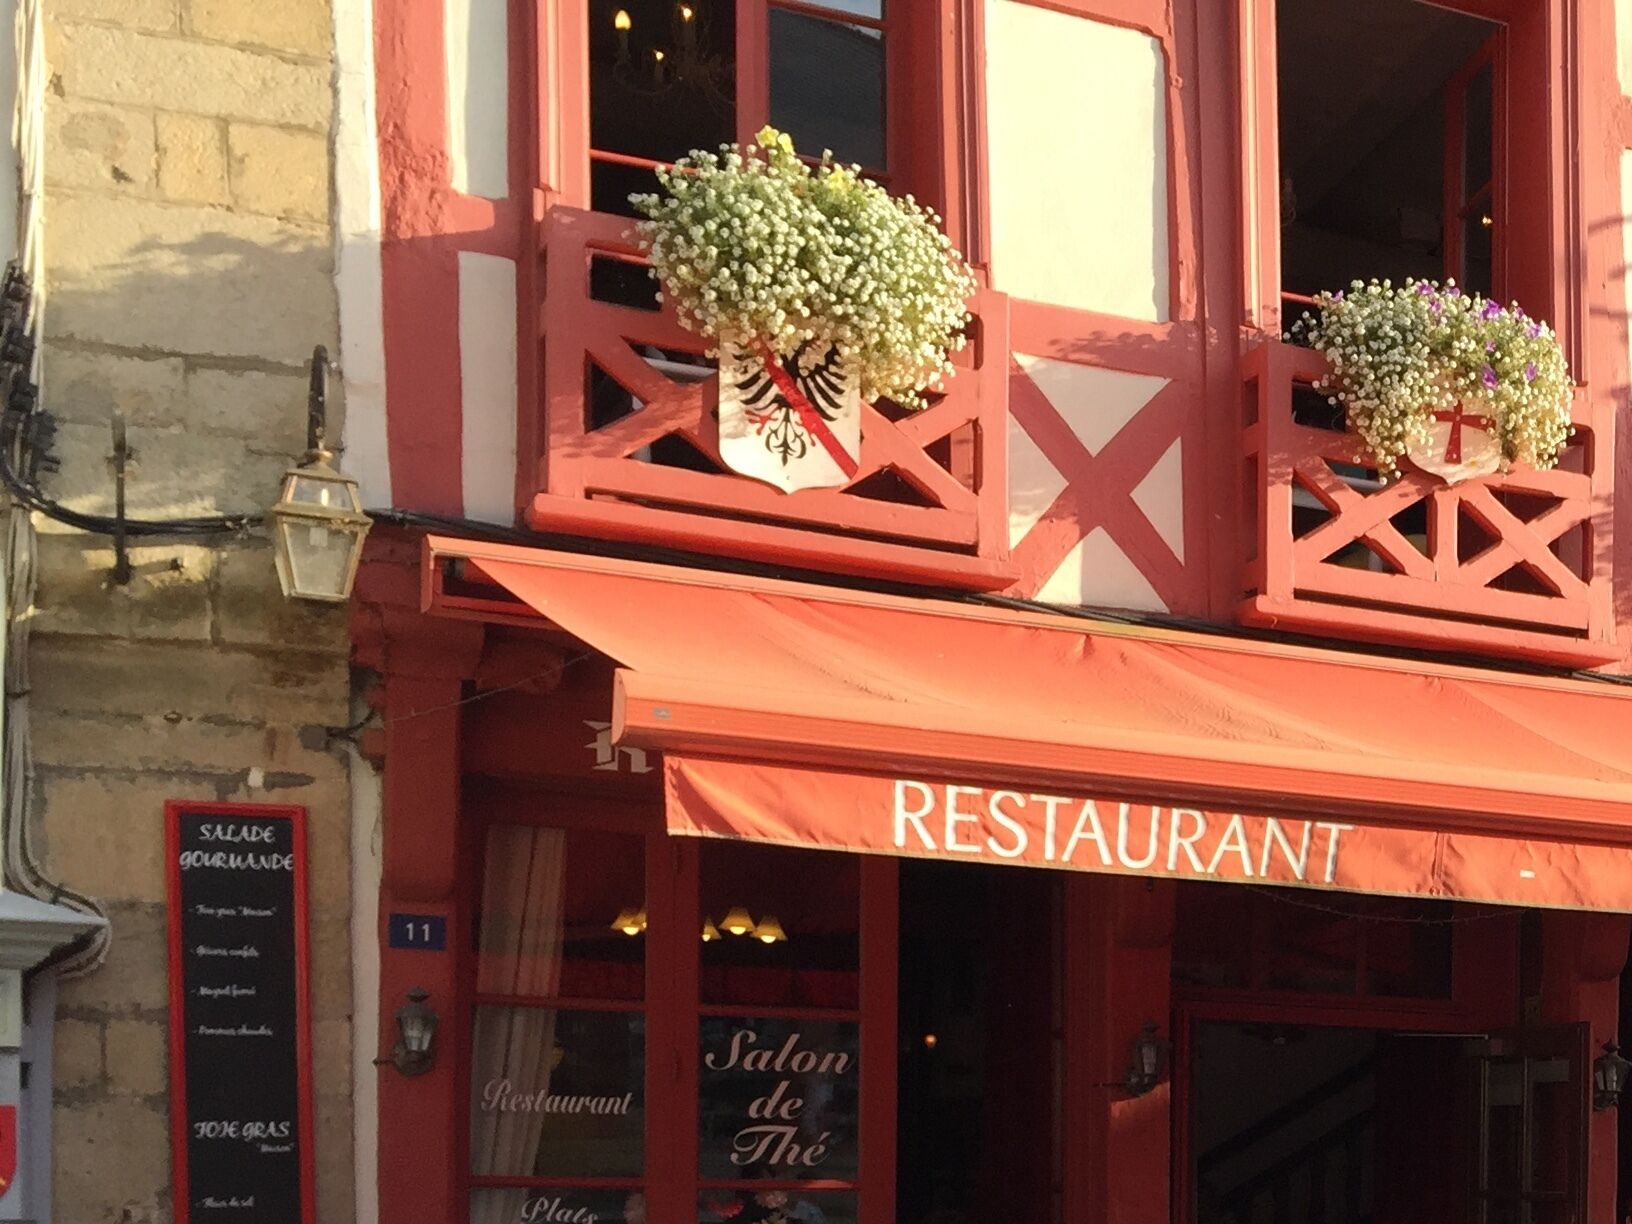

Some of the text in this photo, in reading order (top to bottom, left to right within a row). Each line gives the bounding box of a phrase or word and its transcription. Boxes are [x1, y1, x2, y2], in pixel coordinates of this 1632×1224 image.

[198, 823, 276, 843] SALADE
[893, 779, 1355, 884] RESTAURANT
[405, 921, 431, 942] 11
[705, 1029, 850, 1074] Salon
[480, 1077, 633, 1115] Restaurant
[748, 1080, 804, 1120] de
[241, 1120, 291, 1142] GRAS
[729, 1124, 830, 1167] Thé
